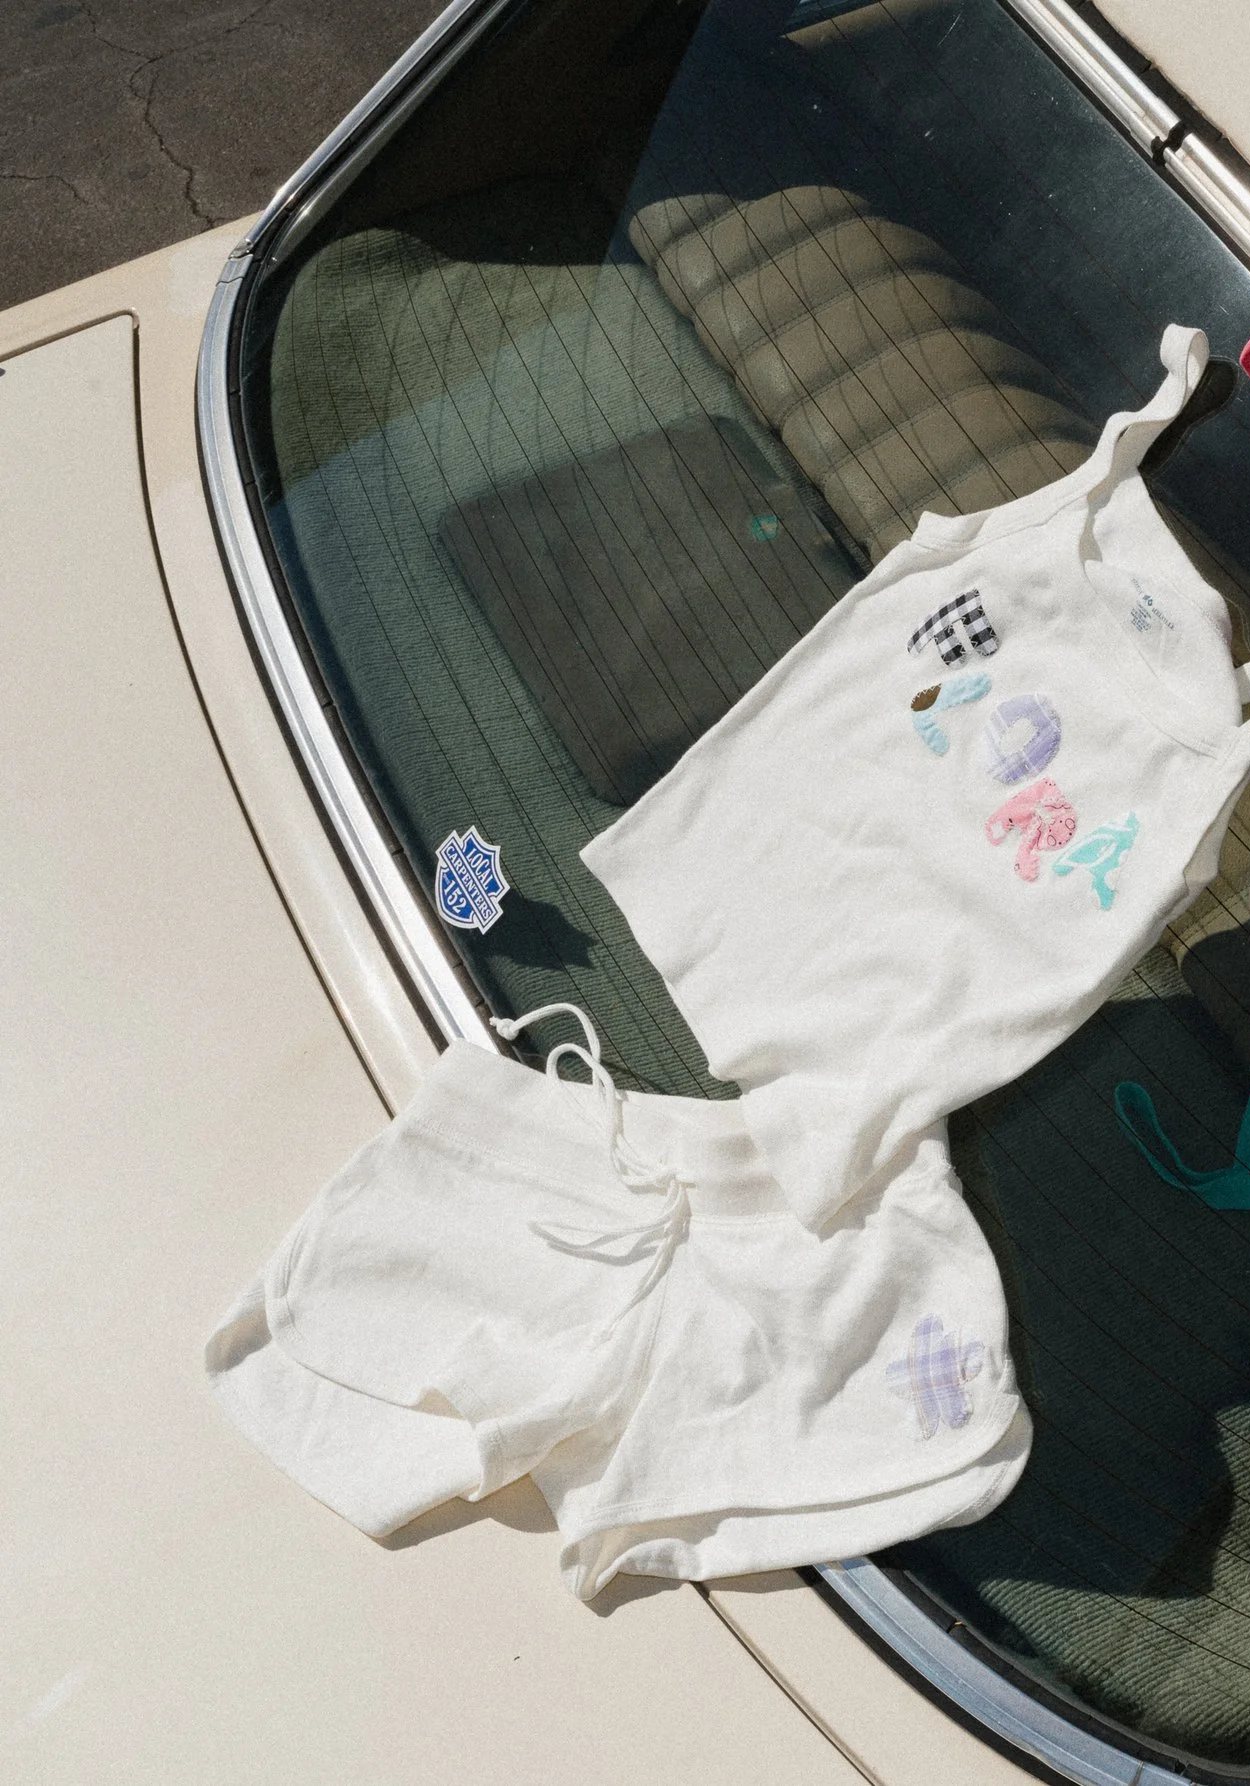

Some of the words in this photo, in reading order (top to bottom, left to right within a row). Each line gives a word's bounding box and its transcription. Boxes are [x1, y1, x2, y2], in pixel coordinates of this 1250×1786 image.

[906, 587, 1141, 912] FLORA
[443, 880, 468, 914] 152
[445, 844, 493, 920] CARPENTERS
[466, 847, 494, 890] LOCAL
